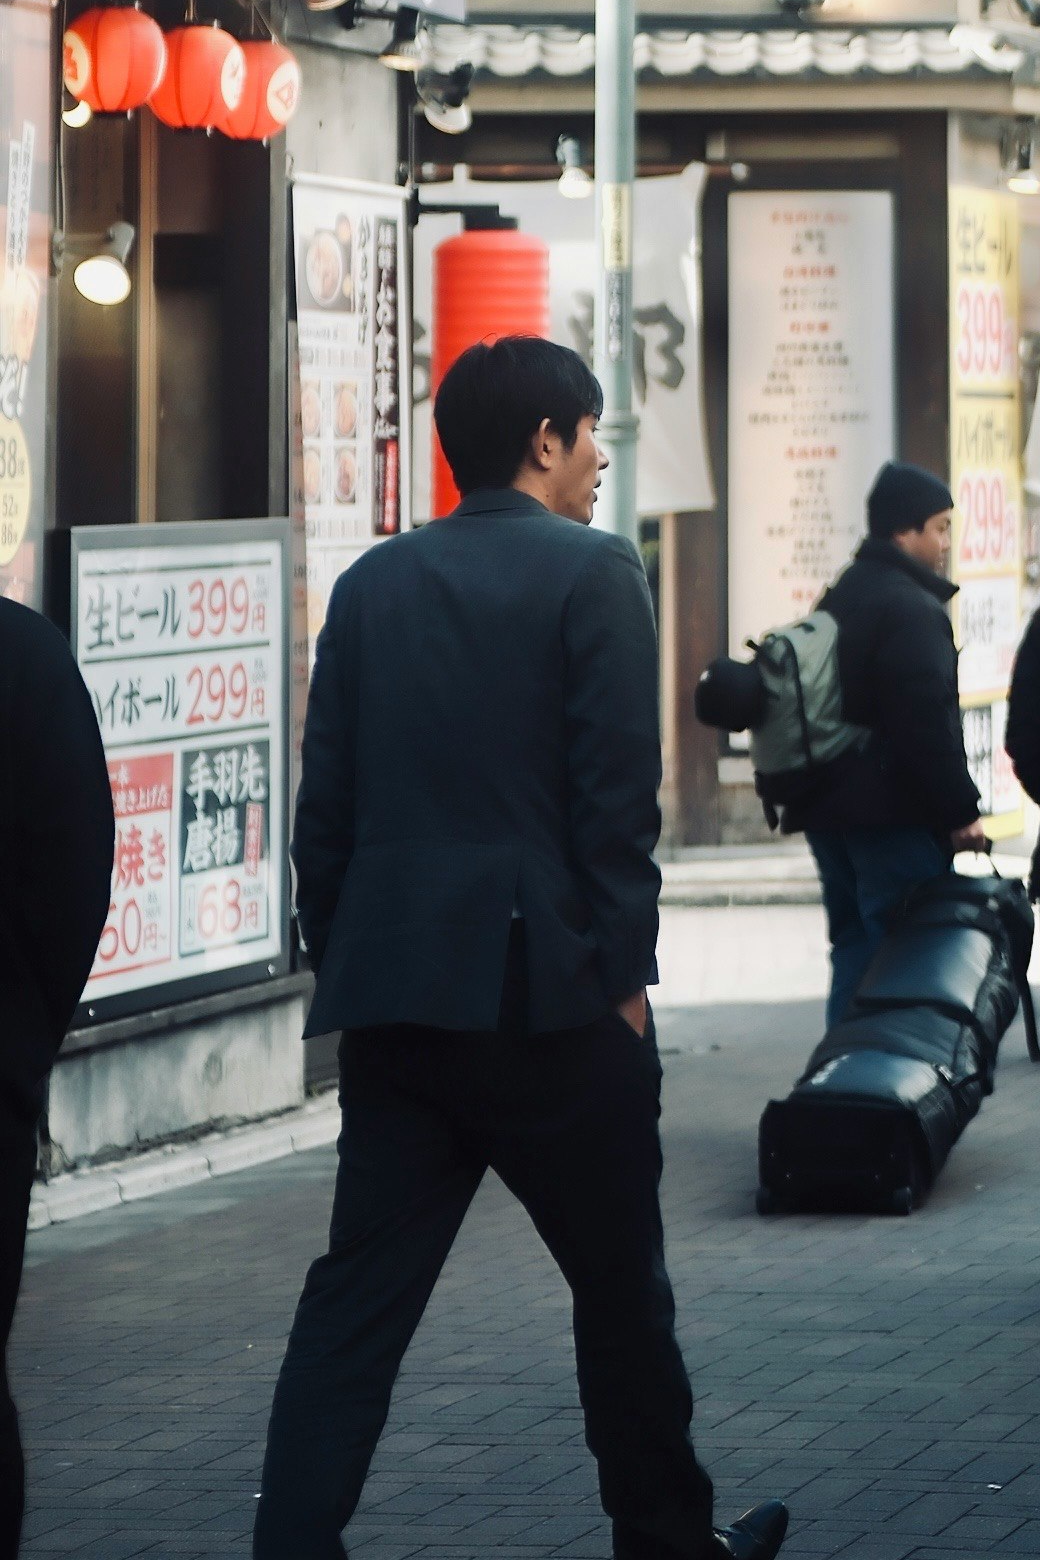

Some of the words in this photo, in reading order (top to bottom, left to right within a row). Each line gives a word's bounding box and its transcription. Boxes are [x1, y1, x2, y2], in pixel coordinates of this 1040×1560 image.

[86, 583, 182, 651] 生ビール
[187, 576, 267, 638] 399円
[186, 661, 267, 726] 299円
[185, 743, 268, 812] 手羽先
[183, 804, 241, 873] 唐揚
[197, 878, 260, 938] 68円
